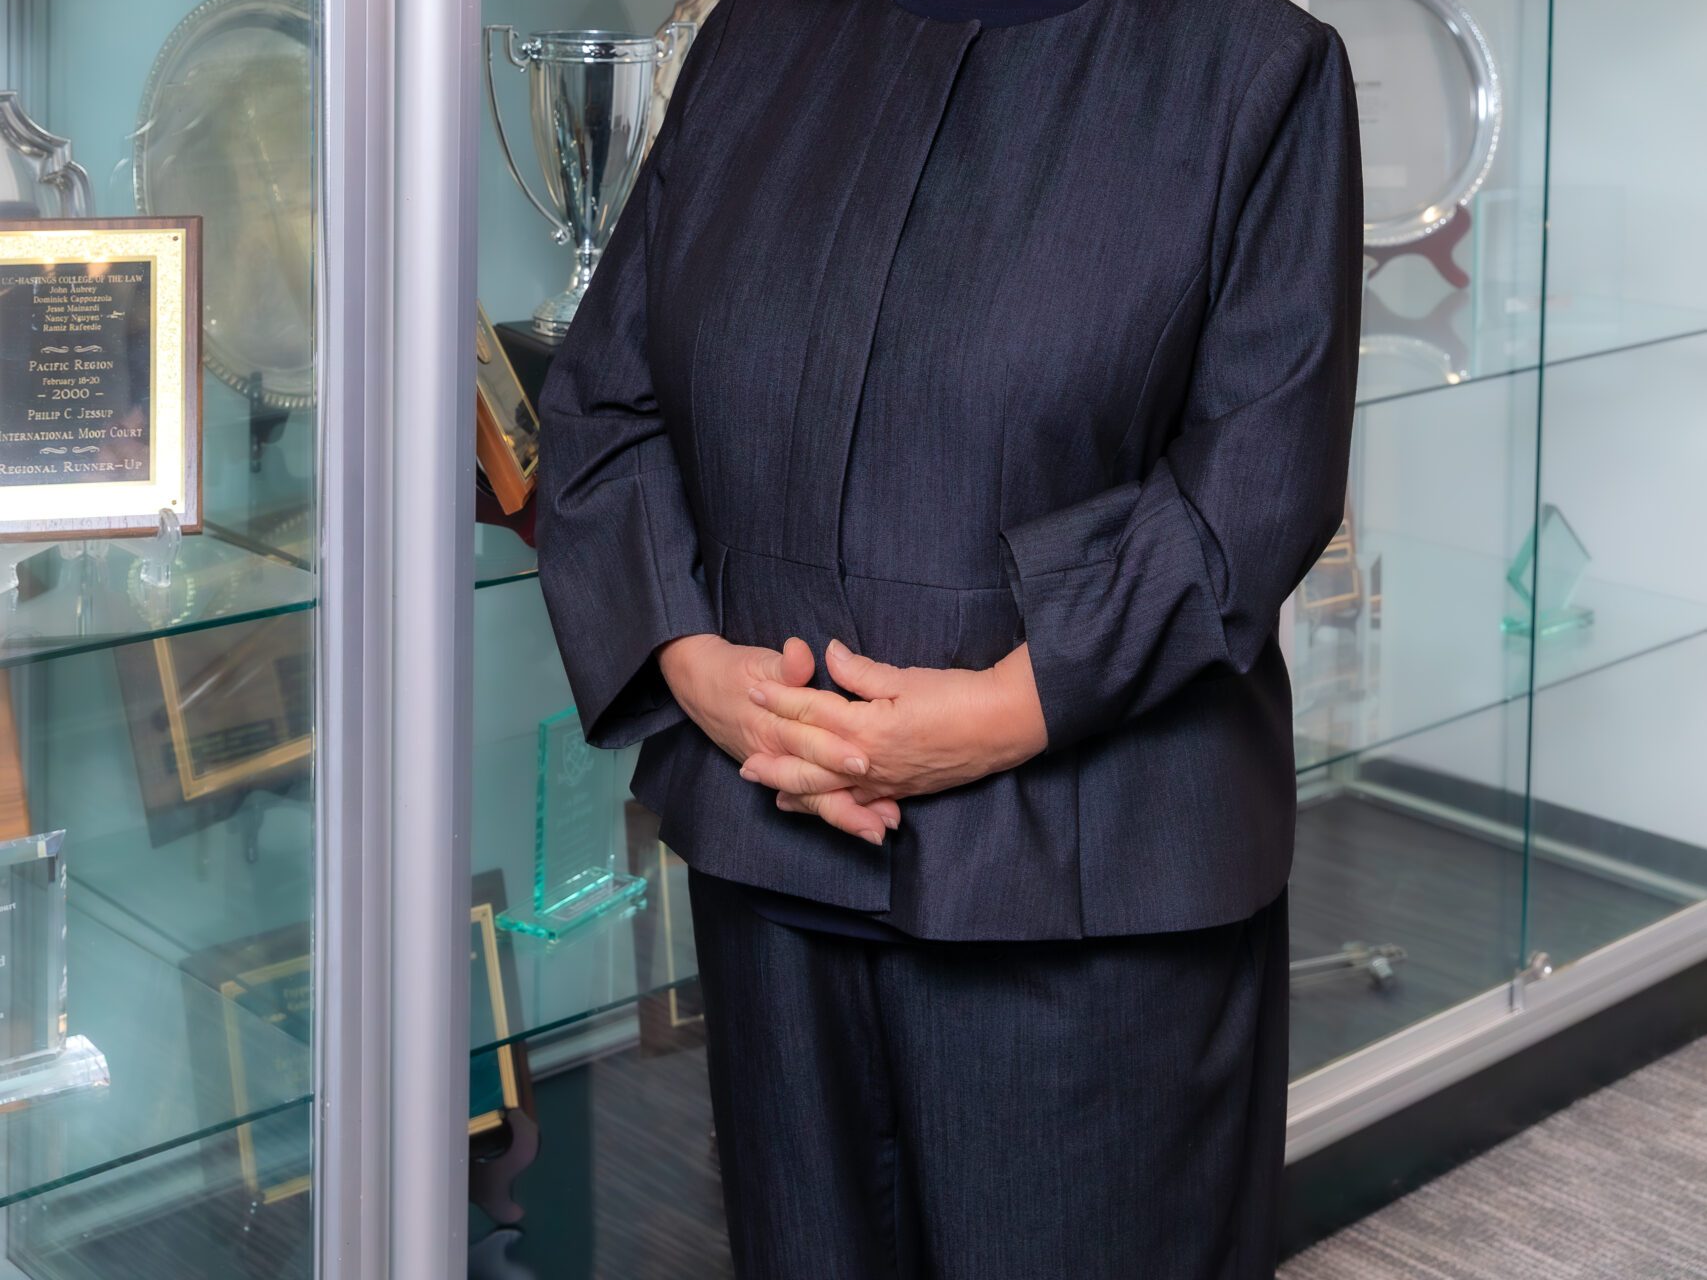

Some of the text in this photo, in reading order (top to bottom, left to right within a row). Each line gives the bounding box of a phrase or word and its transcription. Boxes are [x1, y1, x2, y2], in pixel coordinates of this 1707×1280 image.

[58, 276, 90, 284] COLLEGE
[108, 275, 123, 283] THE
[124, 274, 143, 282] LAW
[50, 286, 97, 294] John Aubrey
[34, 296, 68, 304] Dominick
[72, 314, 100, 322] Nguyen
[29, 359, 114, 371] PACIFIC REGION
[78, 376, 100, 384] 18-20
[52, 388, 90, 399] 2000
[28, 410, 60, 420] PHILIP
[77, 408, 114, 418] JESSUP
[79, 428, 106, 439] MOOT
[110, 427, 142, 437] COURT
[0, 459, 142, 474] REGIONAL RUNNER-UP
